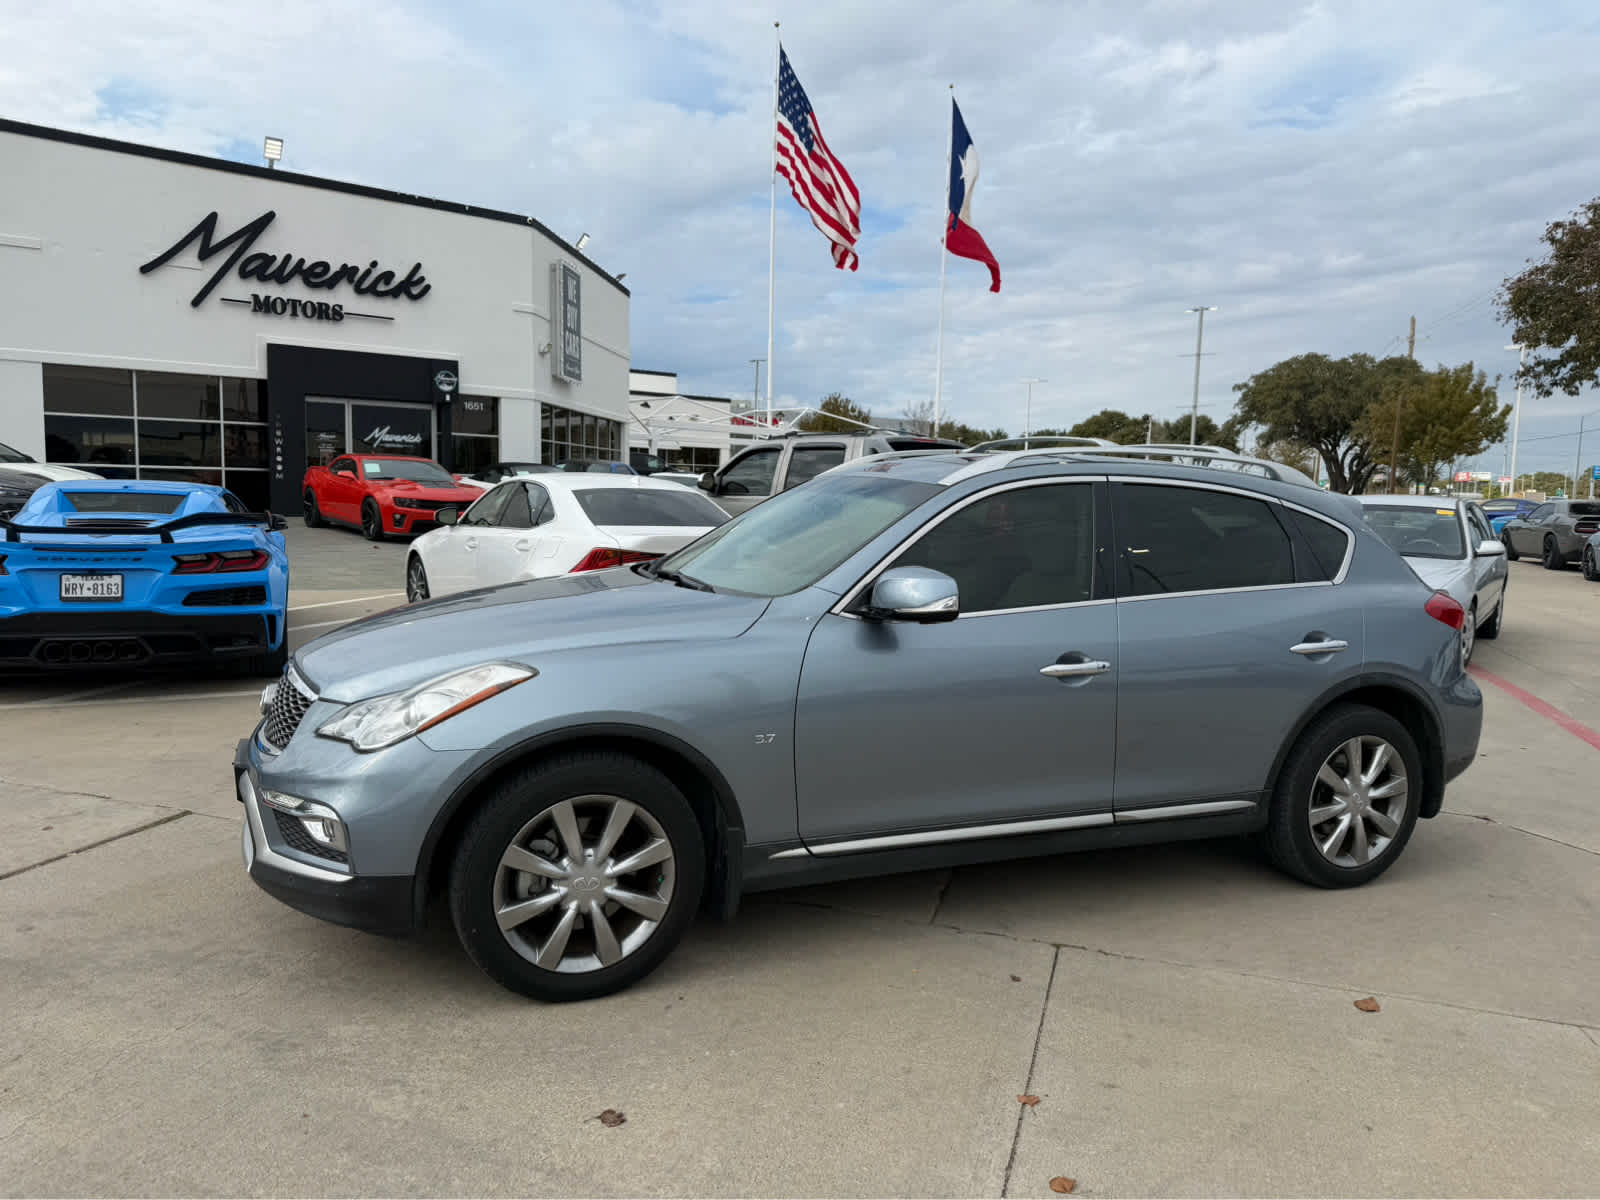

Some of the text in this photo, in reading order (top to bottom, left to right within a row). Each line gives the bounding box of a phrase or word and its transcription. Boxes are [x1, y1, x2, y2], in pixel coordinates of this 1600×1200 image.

[139, 210, 432, 308] Maverick
[251, 294, 345, 321] MOTORS
[464, 401, 484, 411] 1651
[363, 425, 422, 448] Maverick
[754, 733, 776, 744] 3.7
